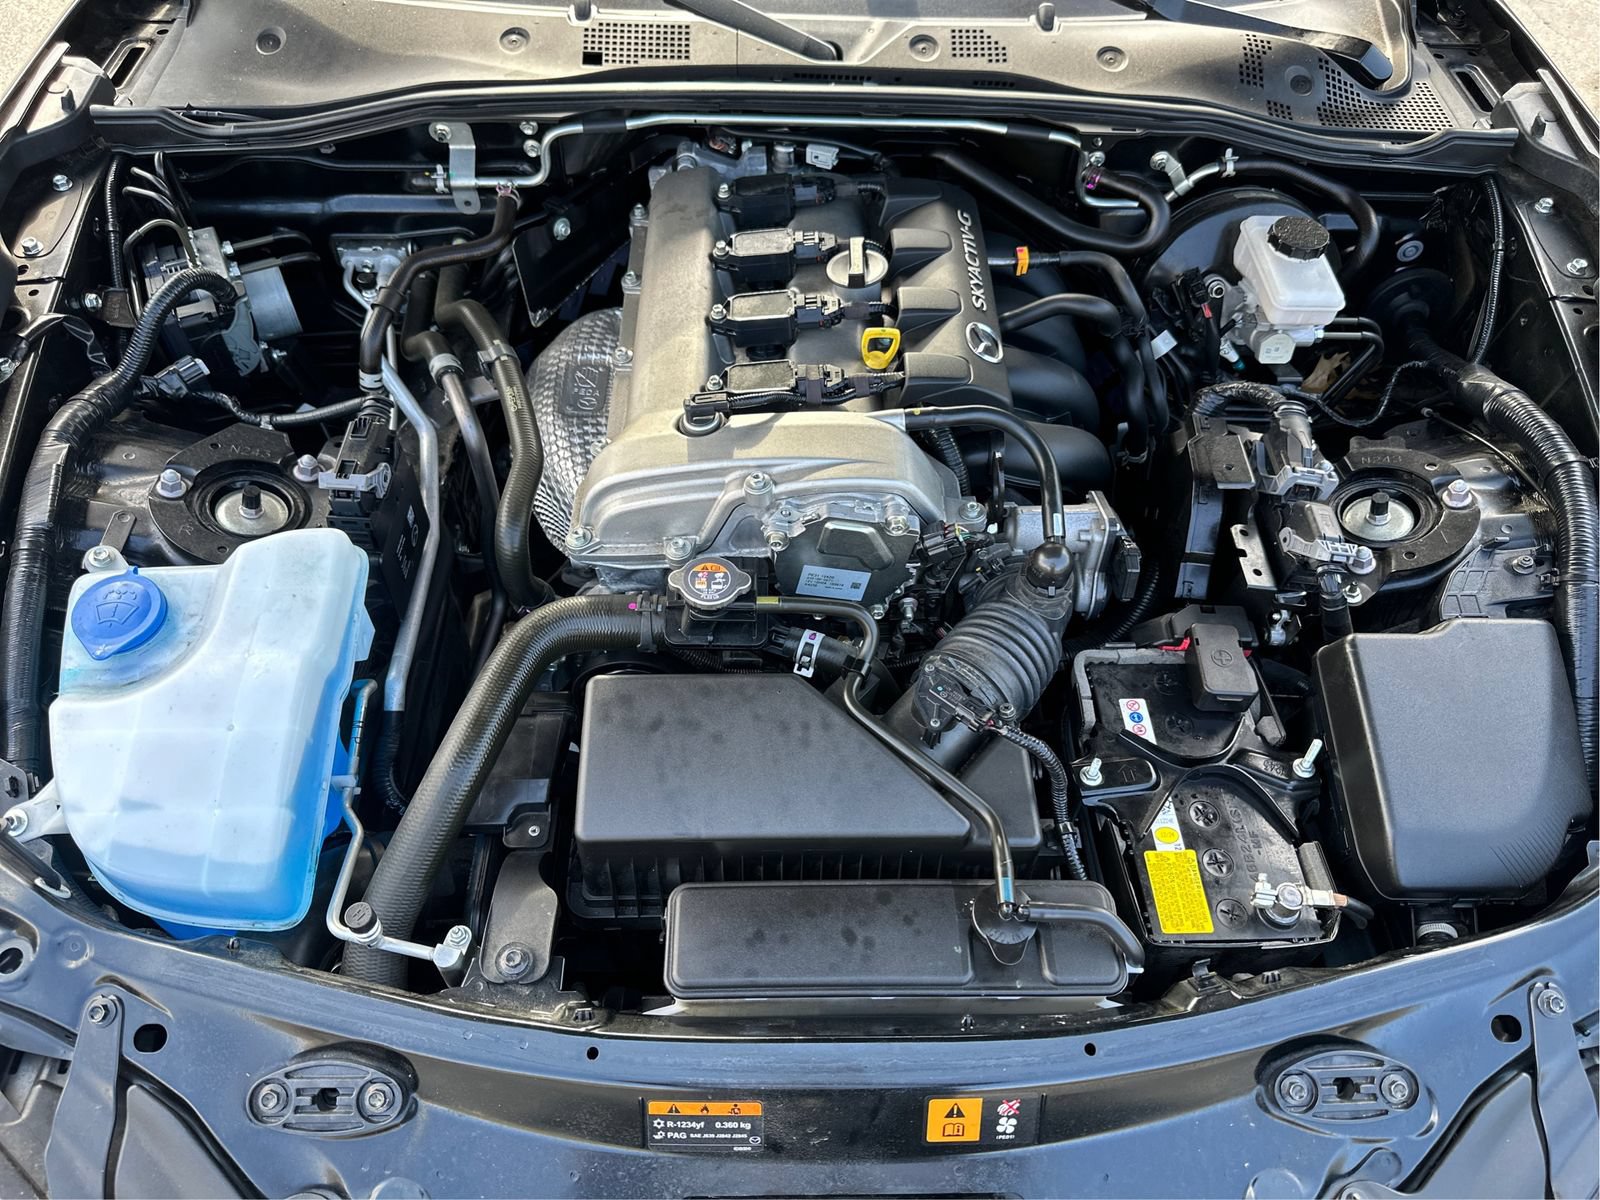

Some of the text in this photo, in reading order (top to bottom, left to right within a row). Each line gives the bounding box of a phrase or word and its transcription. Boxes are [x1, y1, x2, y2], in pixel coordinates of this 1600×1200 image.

[957, 209, 987, 312] SKYACTIV-G
[667, 1121, 705, 1130] R-1234yf
[740, 1121, 752, 1130] kg
